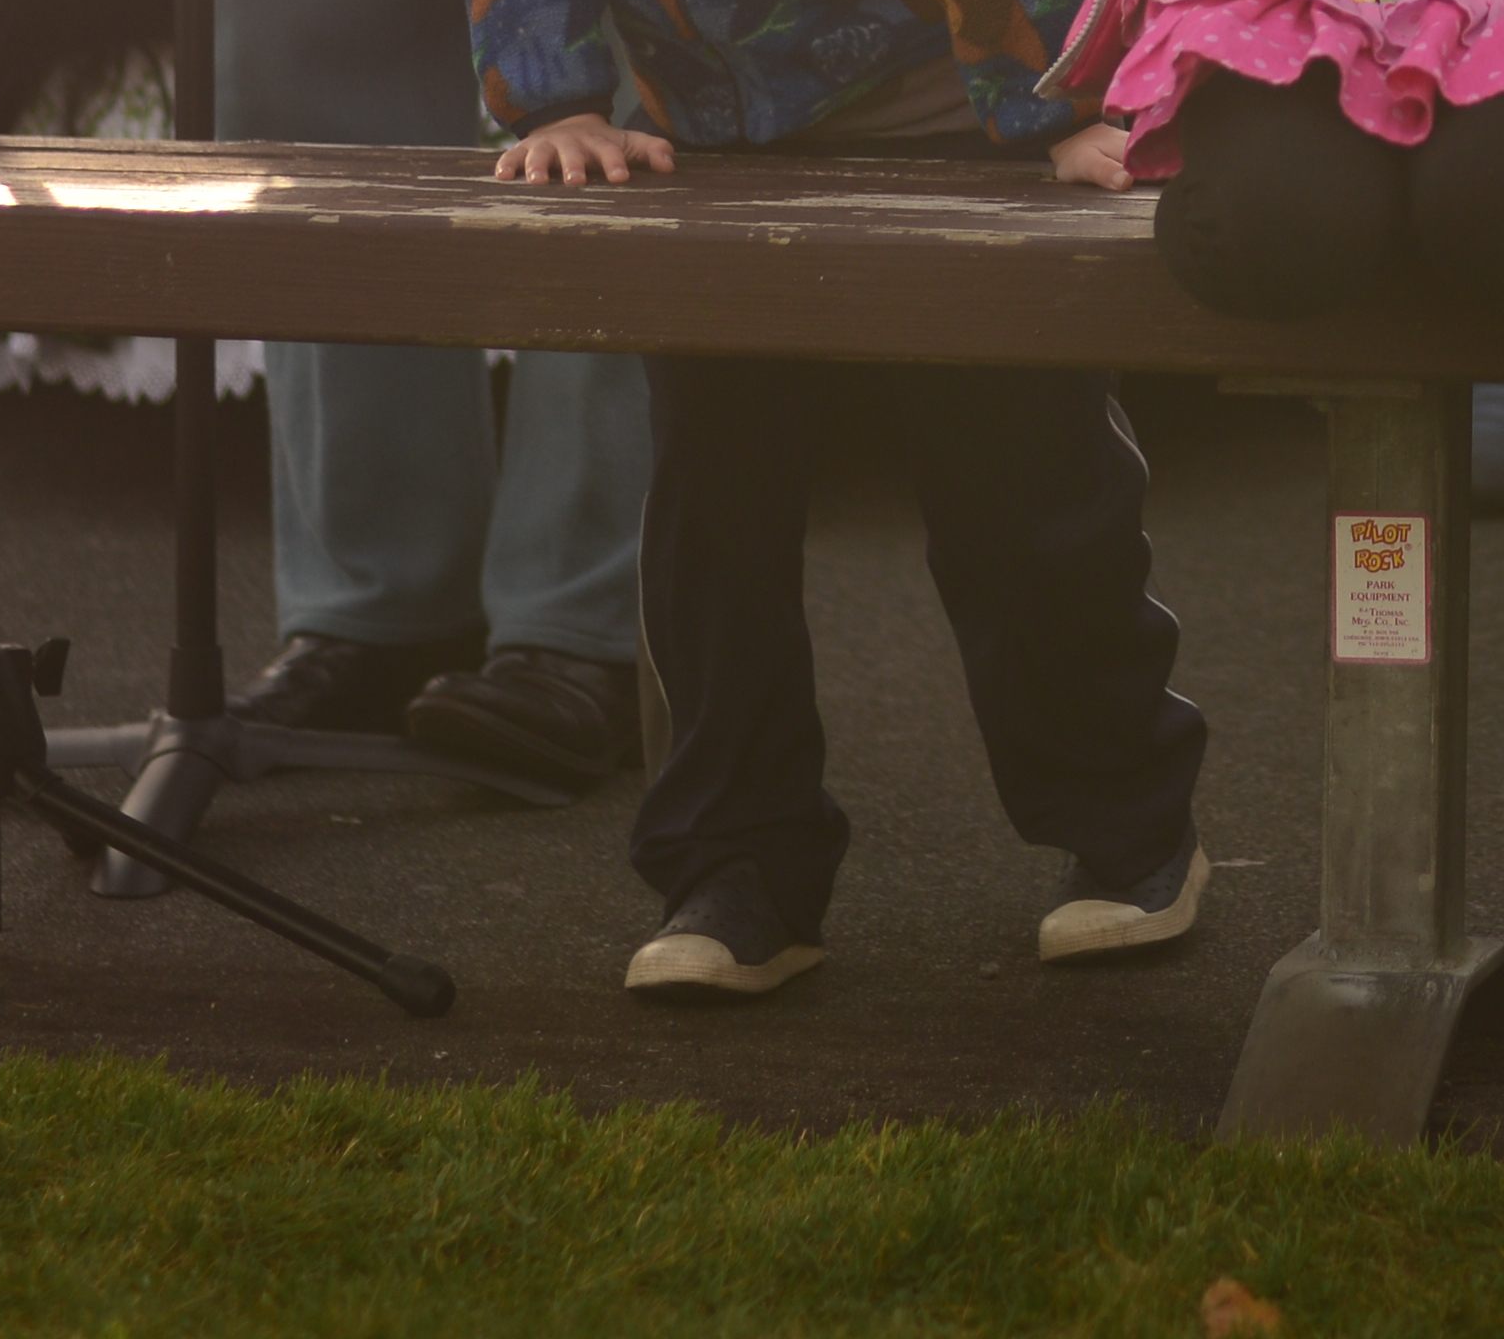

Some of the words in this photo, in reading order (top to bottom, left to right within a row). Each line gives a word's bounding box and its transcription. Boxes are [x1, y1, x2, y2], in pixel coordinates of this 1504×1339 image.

[1351, 519, 1411, 545] PILOT
[1355, 547, 1405, 572] ROCK
[1366, 580, 1395, 590] PARK
[1350, 593, 1411, 603] EQUIPMENT
